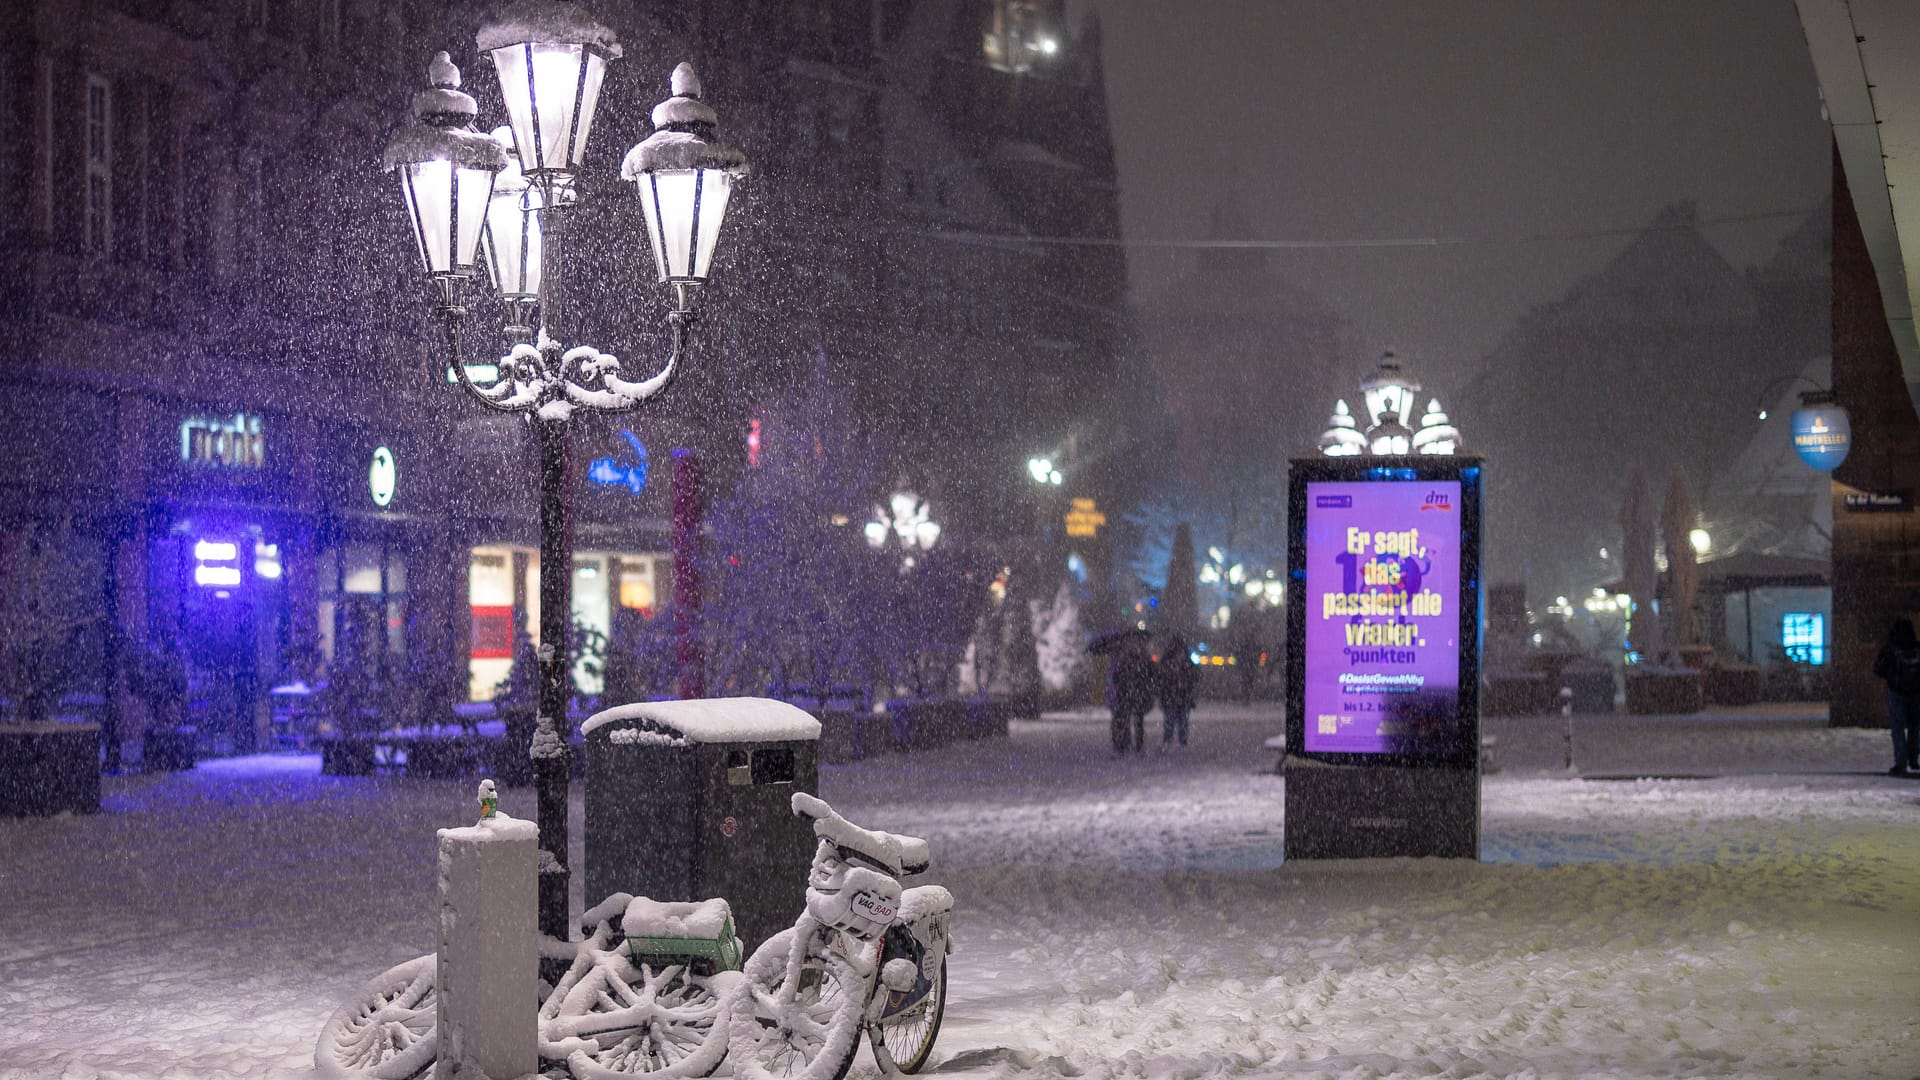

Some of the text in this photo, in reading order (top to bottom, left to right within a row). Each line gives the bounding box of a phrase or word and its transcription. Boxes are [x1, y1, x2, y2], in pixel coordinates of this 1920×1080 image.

[1425, 490, 1448, 504] dm
[1347, 527, 1426, 559] Er sagt,
[1364, 557, 1401, 585] das
[1323, 588, 1442, 620] passiert nie
[1345, 618, 1426, 647] wieder.
[857, 896, 892, 917] VAG RAD
